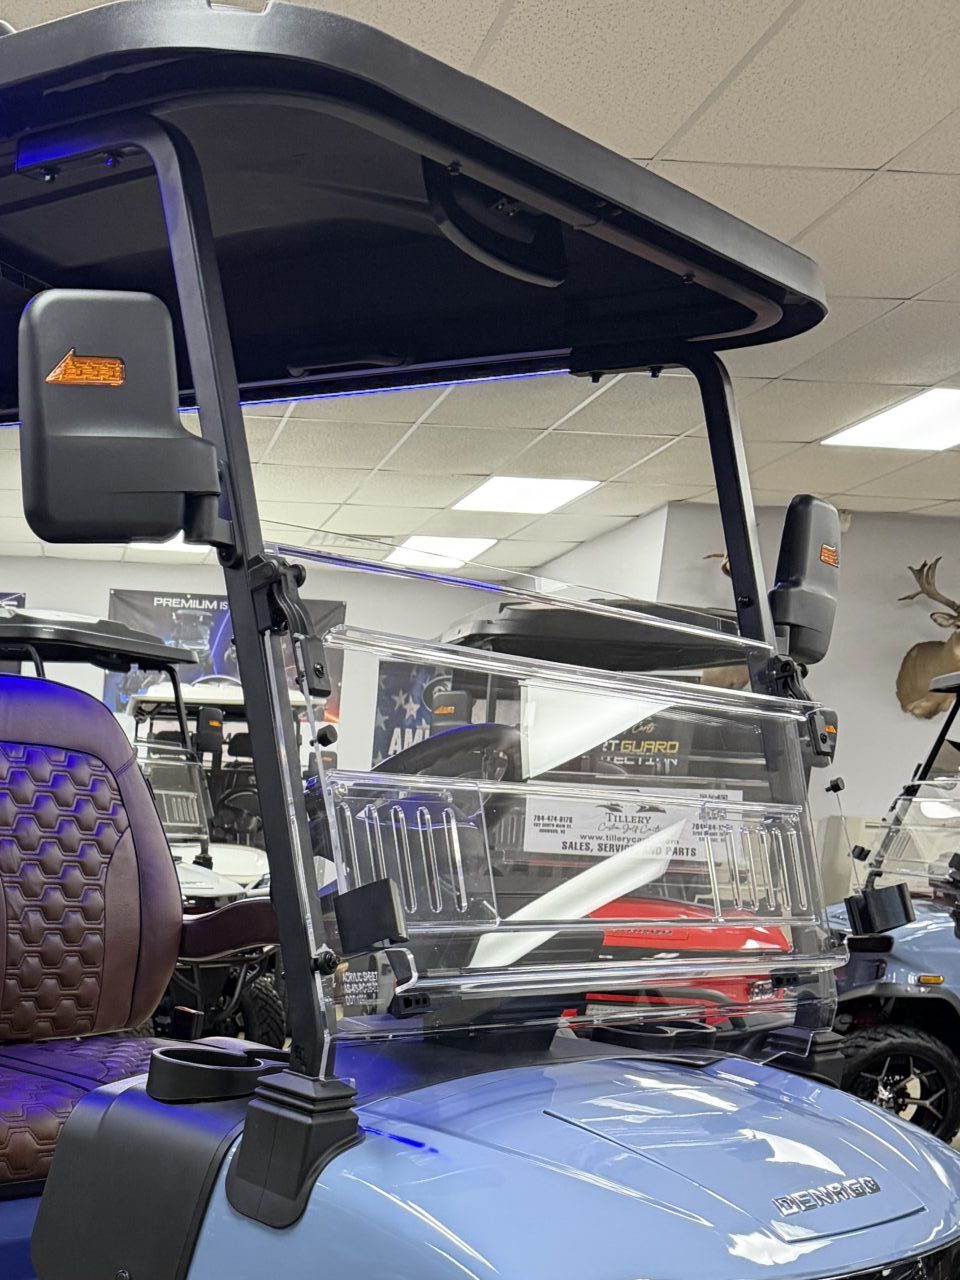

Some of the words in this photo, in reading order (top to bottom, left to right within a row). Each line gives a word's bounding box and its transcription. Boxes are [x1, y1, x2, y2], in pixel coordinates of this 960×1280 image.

[153, 597, 218, 611] PREMIUM
[620, 740, 680, 754] GUARD
[561, 840, 595, 852] SALES,
[771, 1175, 882, 1218] DENAGO
